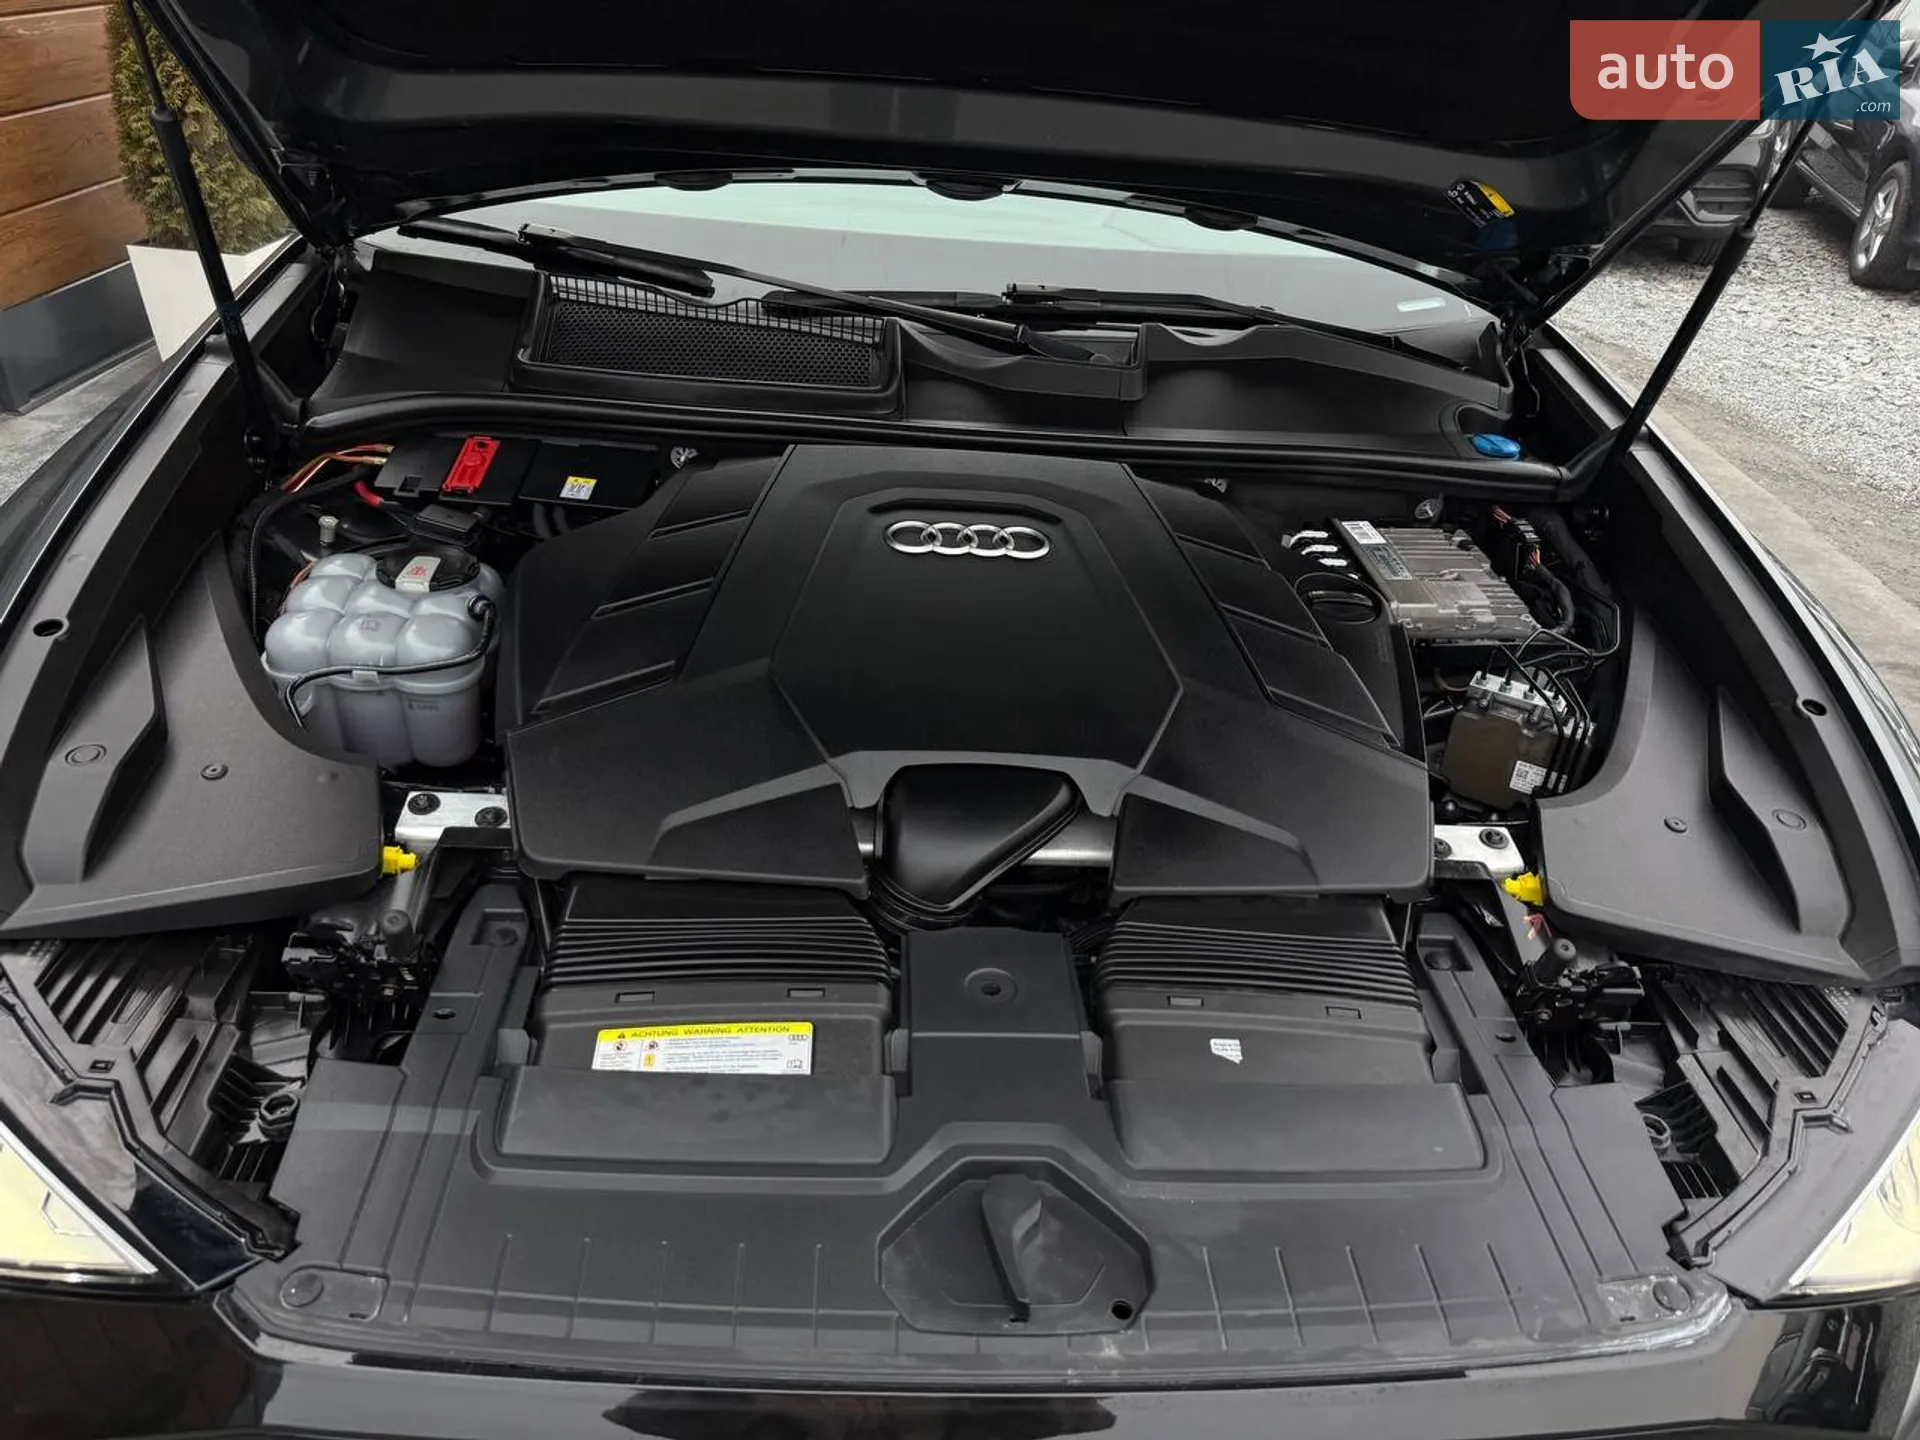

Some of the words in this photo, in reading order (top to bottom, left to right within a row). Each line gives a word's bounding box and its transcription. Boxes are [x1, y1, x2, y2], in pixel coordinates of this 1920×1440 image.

[631, 1028, 678, 1038] ACHTUNG
[683, 1026, 732, 1035] WARNING
[736, 1024, 791, 1033] ATTENTION
